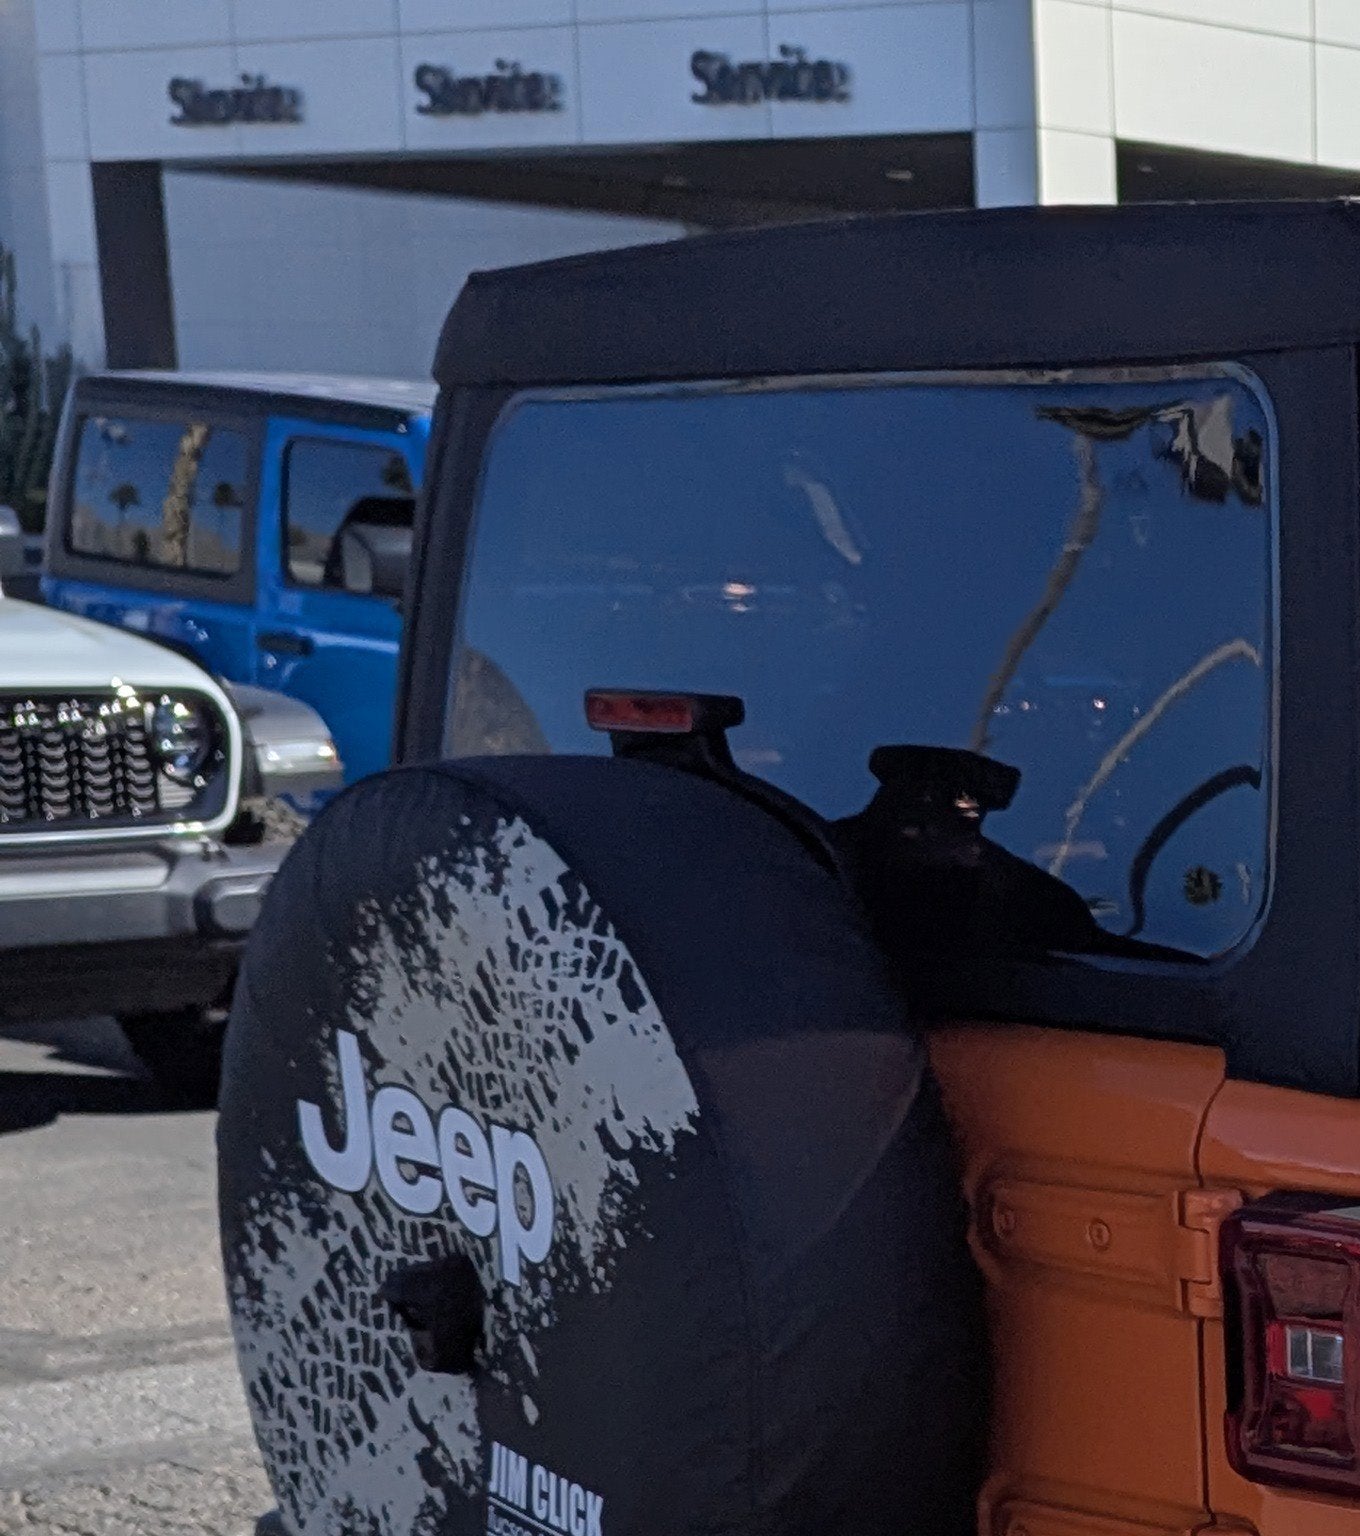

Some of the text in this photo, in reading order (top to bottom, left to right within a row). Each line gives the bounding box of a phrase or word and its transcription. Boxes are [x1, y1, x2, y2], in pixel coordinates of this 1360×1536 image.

[415, 58, 563, 114] Service
[690, 44, 852, 106] Service
[298, 1028, 554, 1287] Jeep
[488, 1440, 528, 1510] JIM
